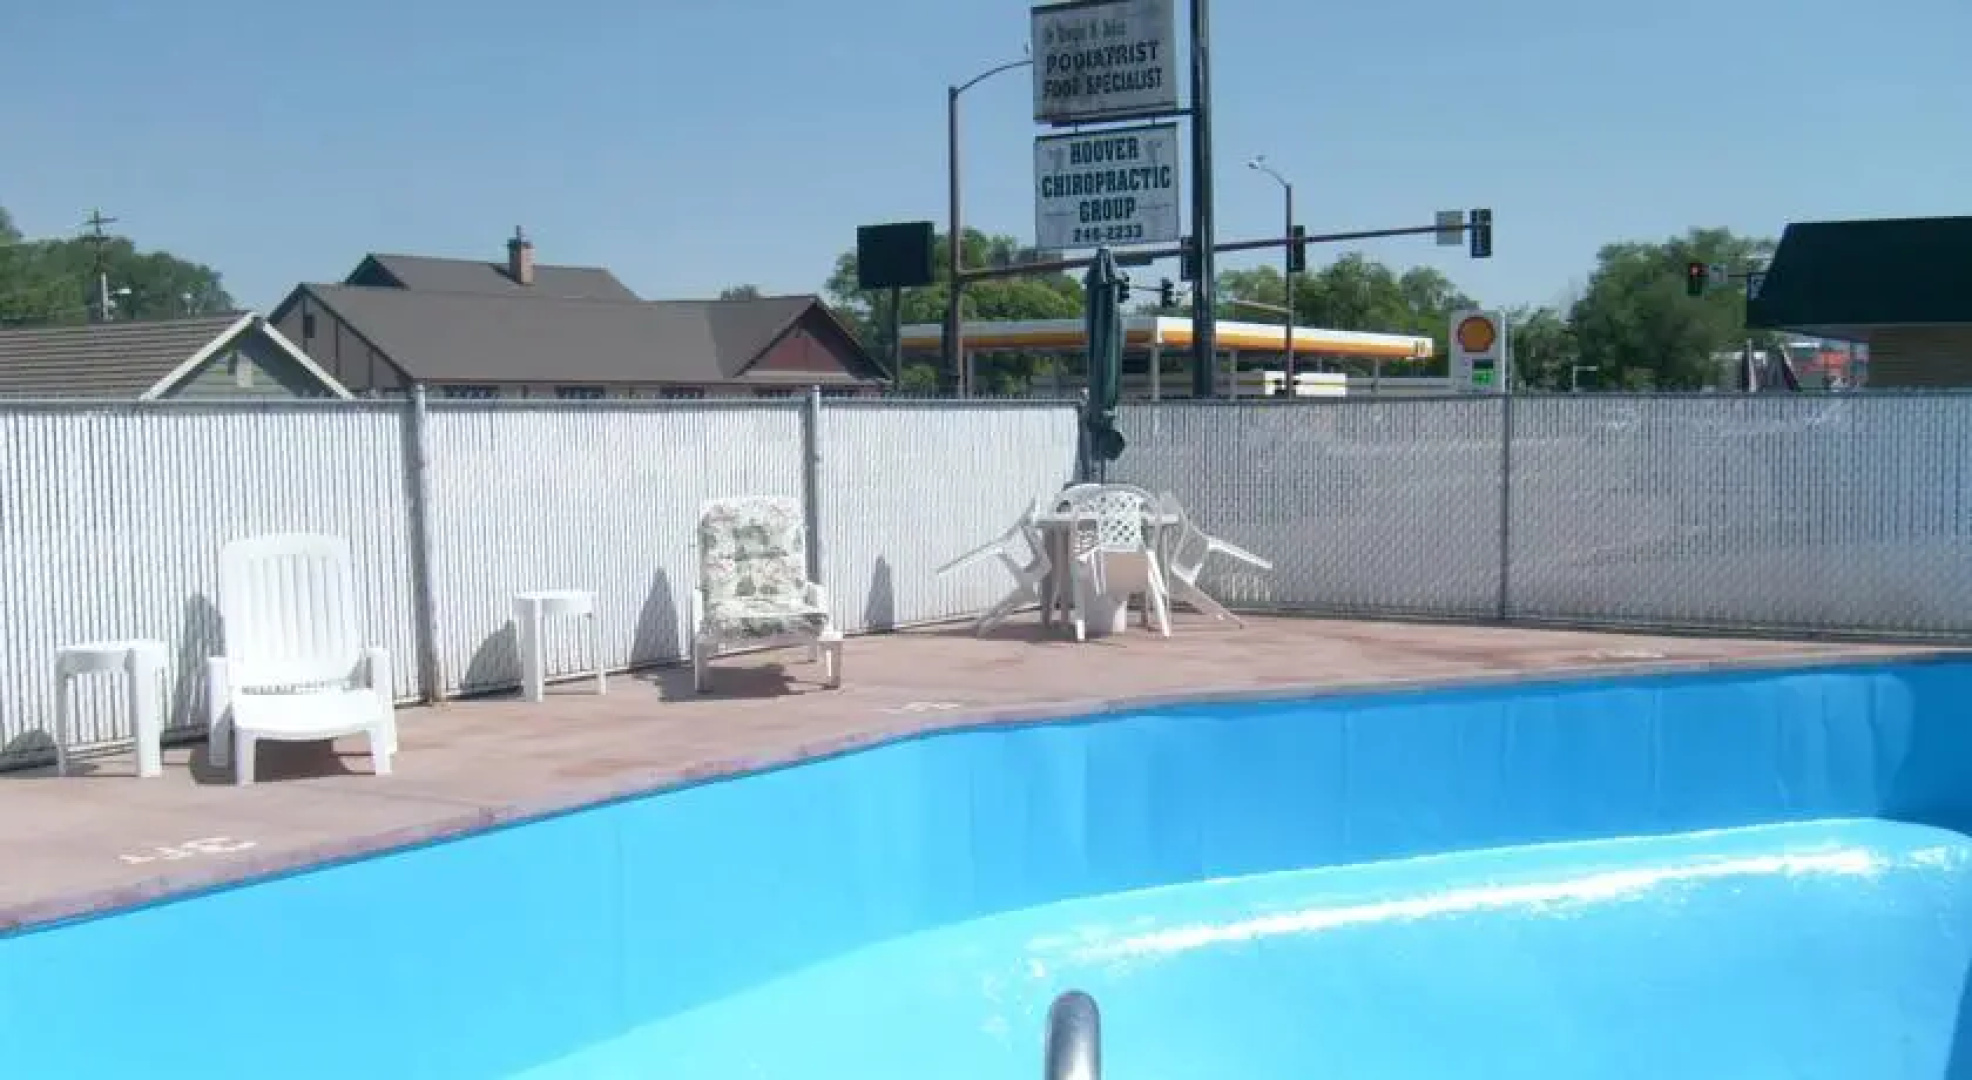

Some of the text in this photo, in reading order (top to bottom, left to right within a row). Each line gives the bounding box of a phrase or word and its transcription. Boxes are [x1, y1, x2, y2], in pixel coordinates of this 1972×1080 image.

[1046, 40, 1159, 74] PODIATRIST
[1086, 67, 1162, 94] SPECIALIST
[1070, 138, 1139, 164] HOOVER
[1042, 166, 1171, 198] CHIROPRACTIC
[1080, 197, 1135, 223] GROUP
